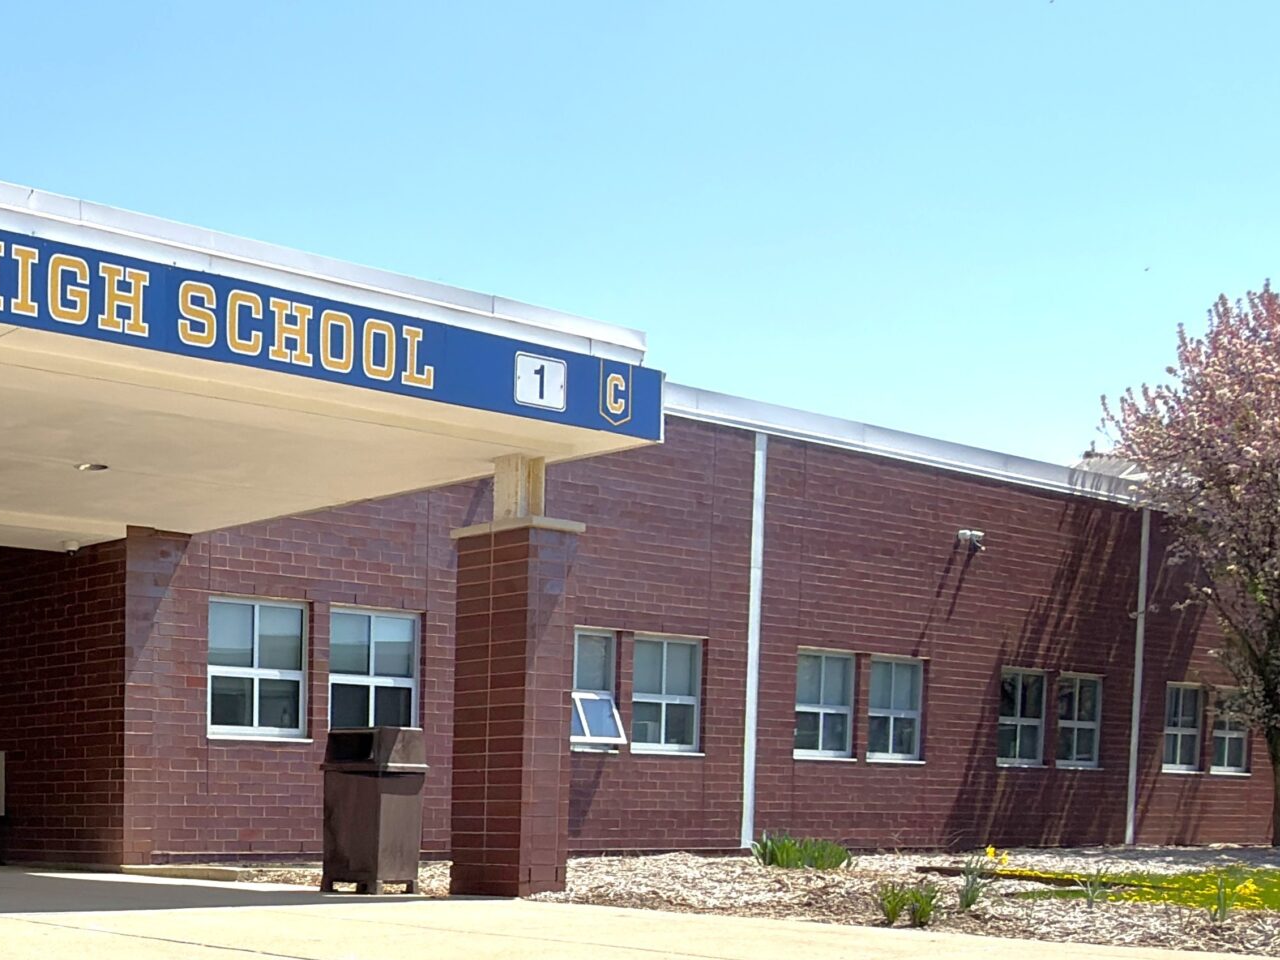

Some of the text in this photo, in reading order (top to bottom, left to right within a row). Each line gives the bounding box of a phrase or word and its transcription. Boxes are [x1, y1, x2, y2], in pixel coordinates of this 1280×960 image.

[177, 280, 435, 390] SCHOOL
[533, 364, 545, 400] 1
[606, 373, 626, 414] C
